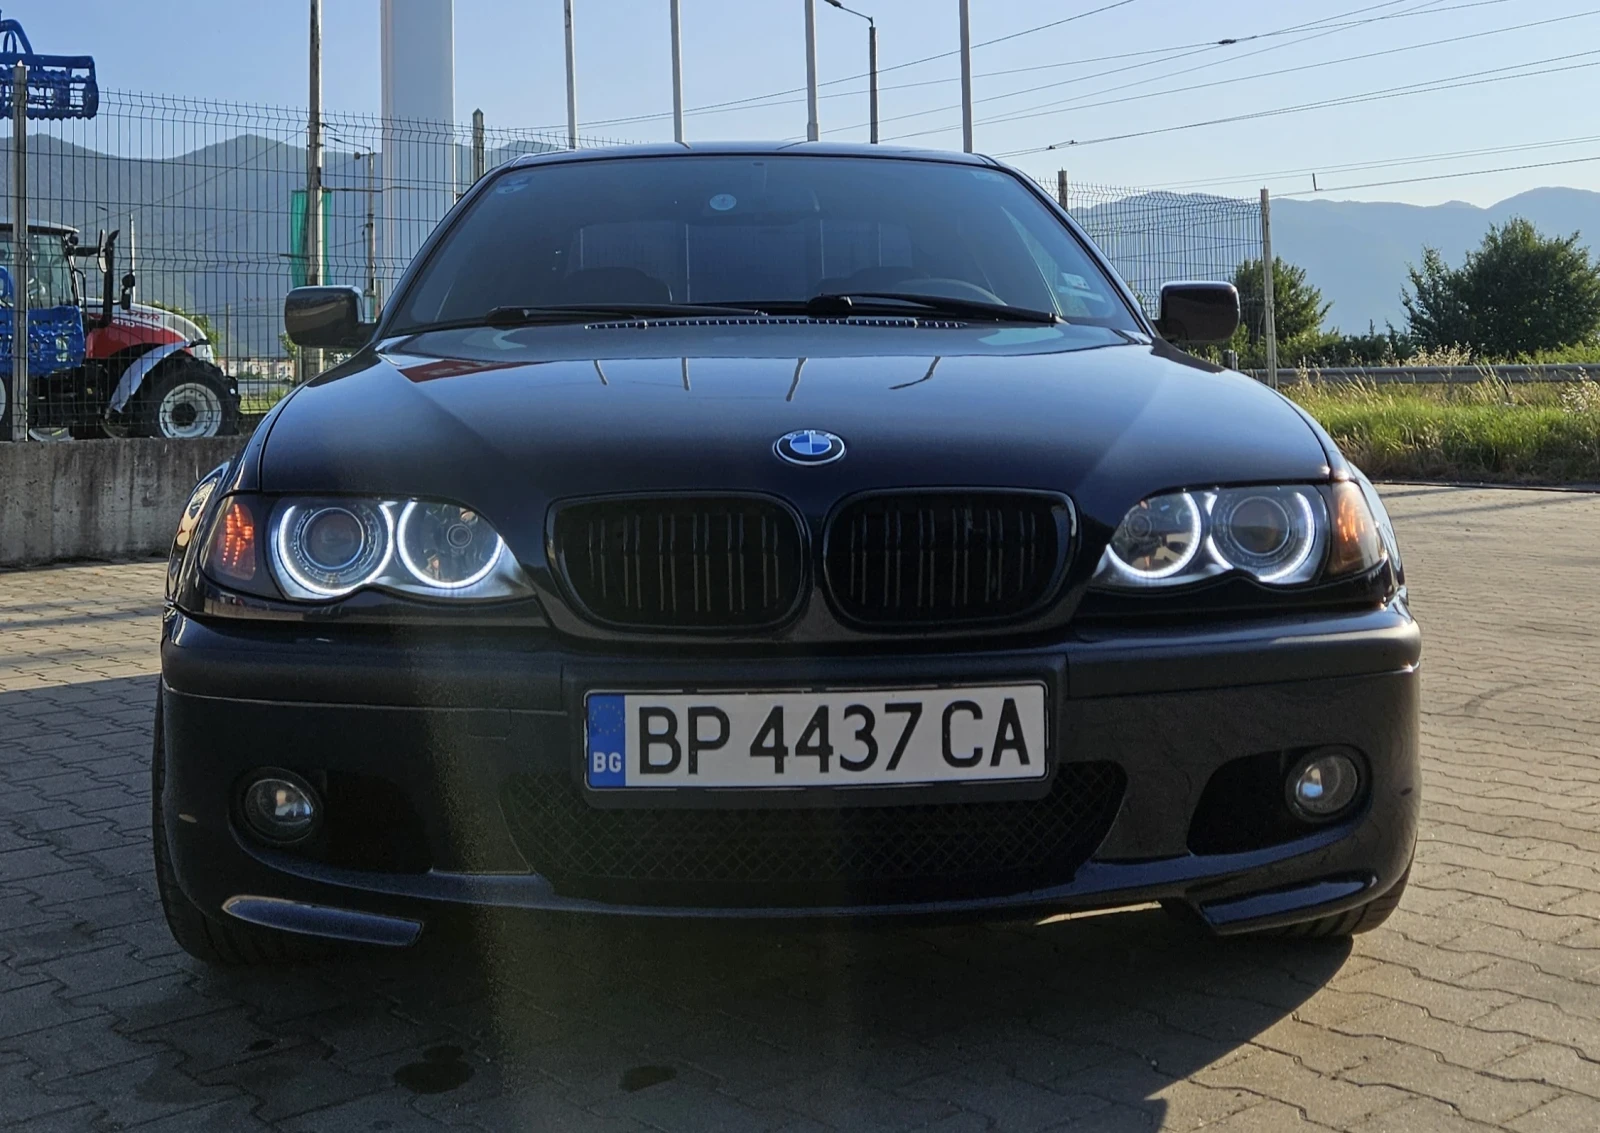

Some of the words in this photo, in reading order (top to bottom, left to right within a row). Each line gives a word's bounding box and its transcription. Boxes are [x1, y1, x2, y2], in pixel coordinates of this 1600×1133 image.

[638, 706, 730, 775] BP
[750, 703, 921, 774] 4437
[942, 698, 1030, 768] CA
[593, 752, 621, 773] BG
